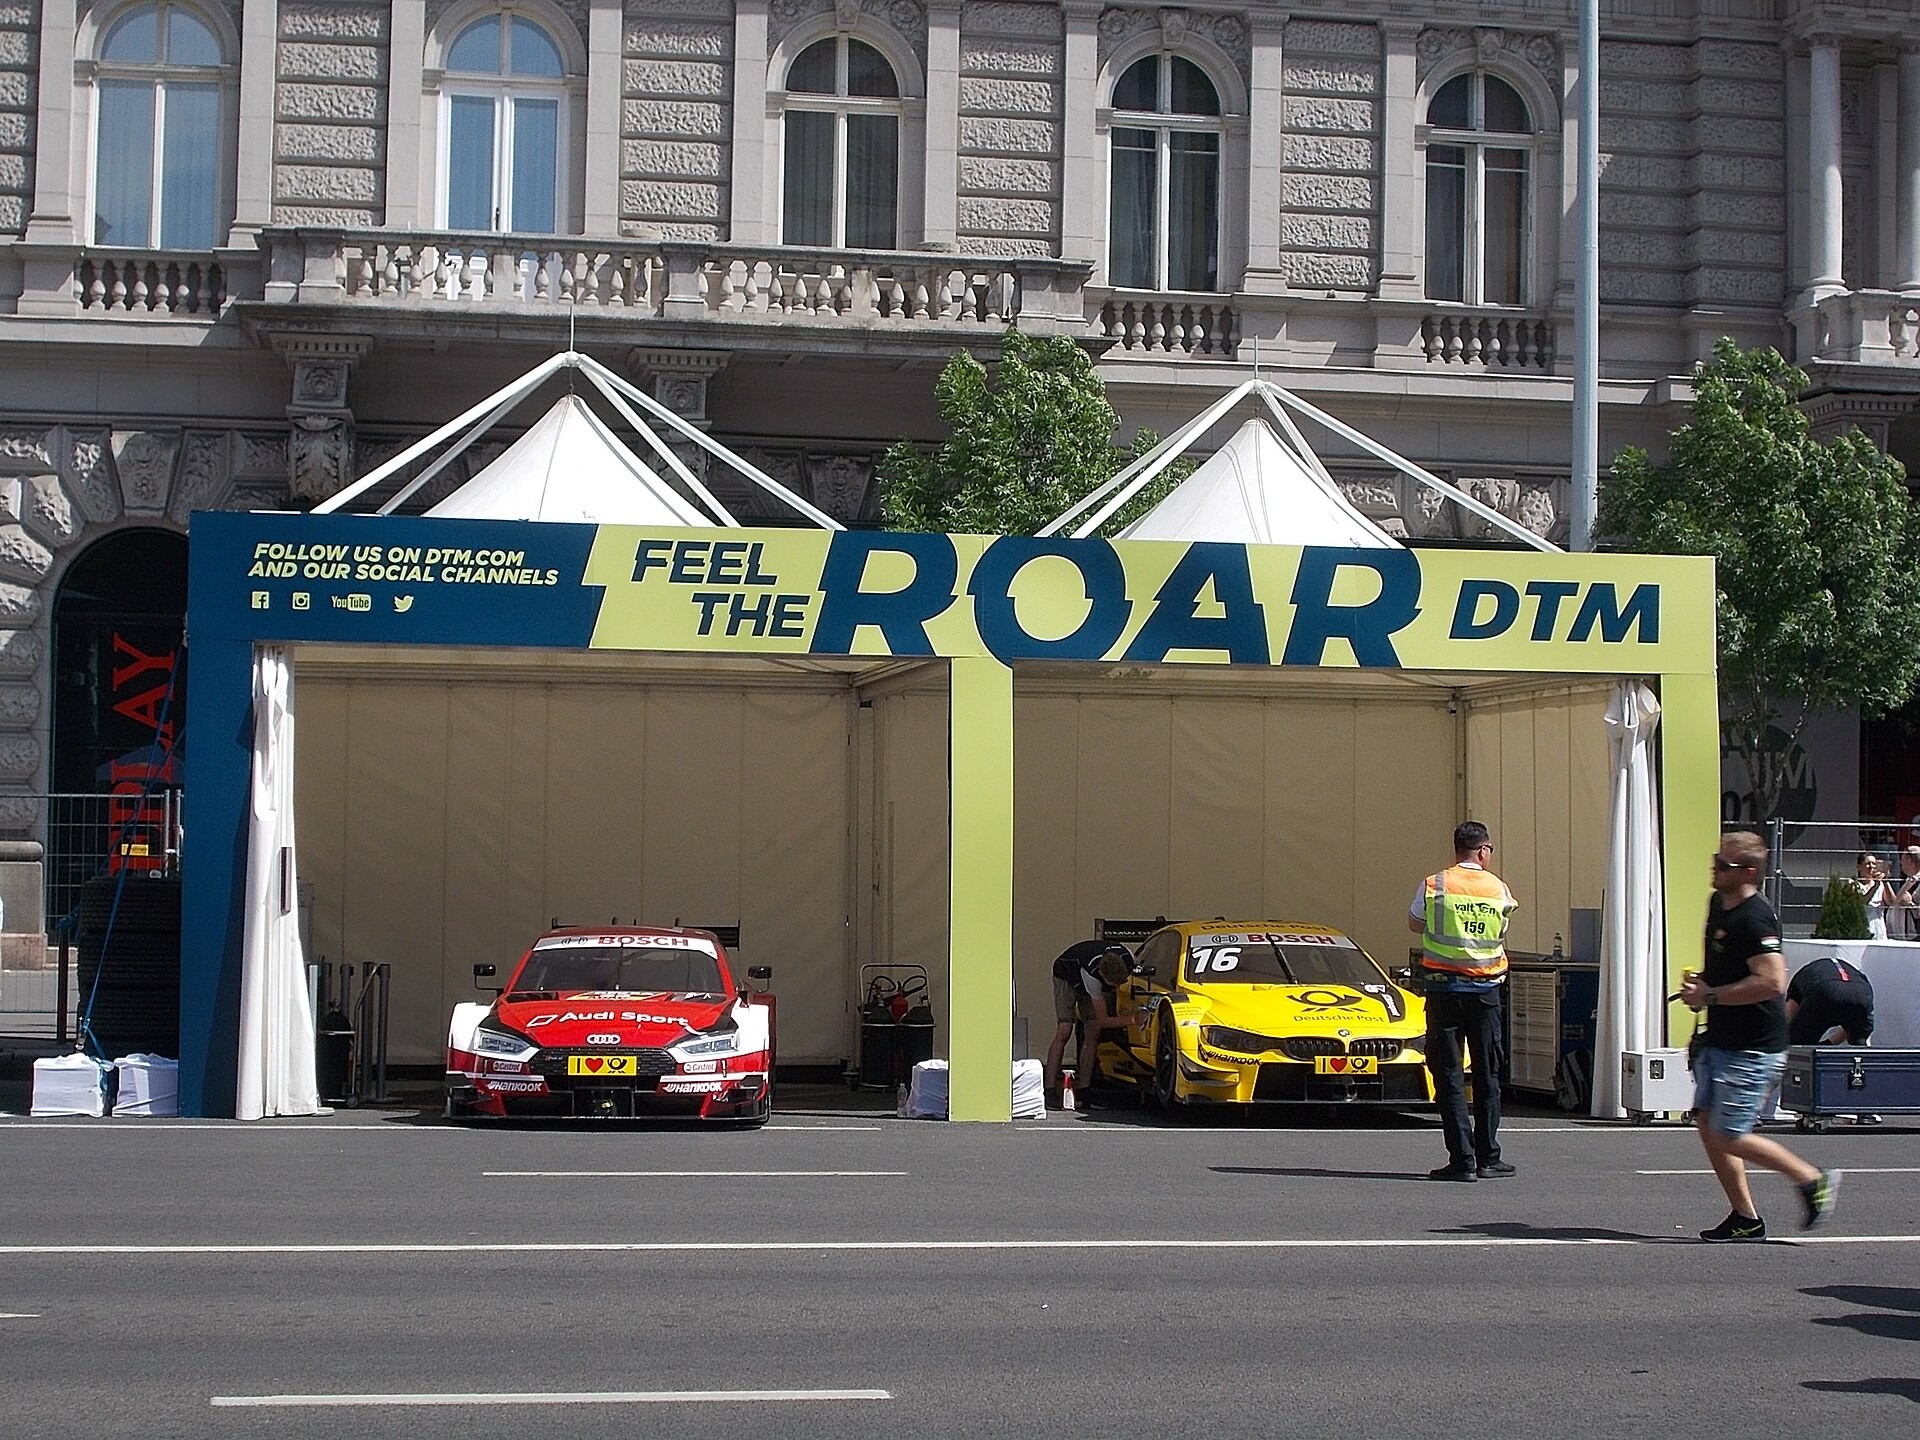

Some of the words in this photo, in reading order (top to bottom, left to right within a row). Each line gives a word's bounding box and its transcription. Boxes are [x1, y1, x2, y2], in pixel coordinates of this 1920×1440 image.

[254, 543, 349, 561] FOLLOW
[354, 546, 383, 562] US
[388, 547, 421, 563] ON
[425, 549, 525, 566] DTM.COM
[631, 538, 779, 587] FEEL
[247, 561, 297, 577] AND
[304, 563, 351, 579] OUR
[354, 564, 434, 581] SOCIAL
[442, 566, 558, 585] CHANNELS
[331, 593, 372, 612] YouTube
[809, 531, 1421, 668] ROAR
[691, 593, 812, 639] THE
[1449, 578, 1661, 645] DTM
[1201, 923, 1284, 932] Deutsche
[1290, 924, 1329, 932] Post
[1463, 920, 1486, 935] 159
[598, 936, 690, 947] BOSCH
[1247, 933, 1337, 945] BOSCH
[1191, 947, 1242, 974] 16
[559, 1011, 615, 1022] Audi
[621, 1012, 690, 1027] Sport
[1293, 1014, 1353, 1022] Deutsche
[1356, 1015, 1385, 1023] Post
[499, 1063, 521, 1072] Castrol
[692, 1063, 715, 1072] Castrol
